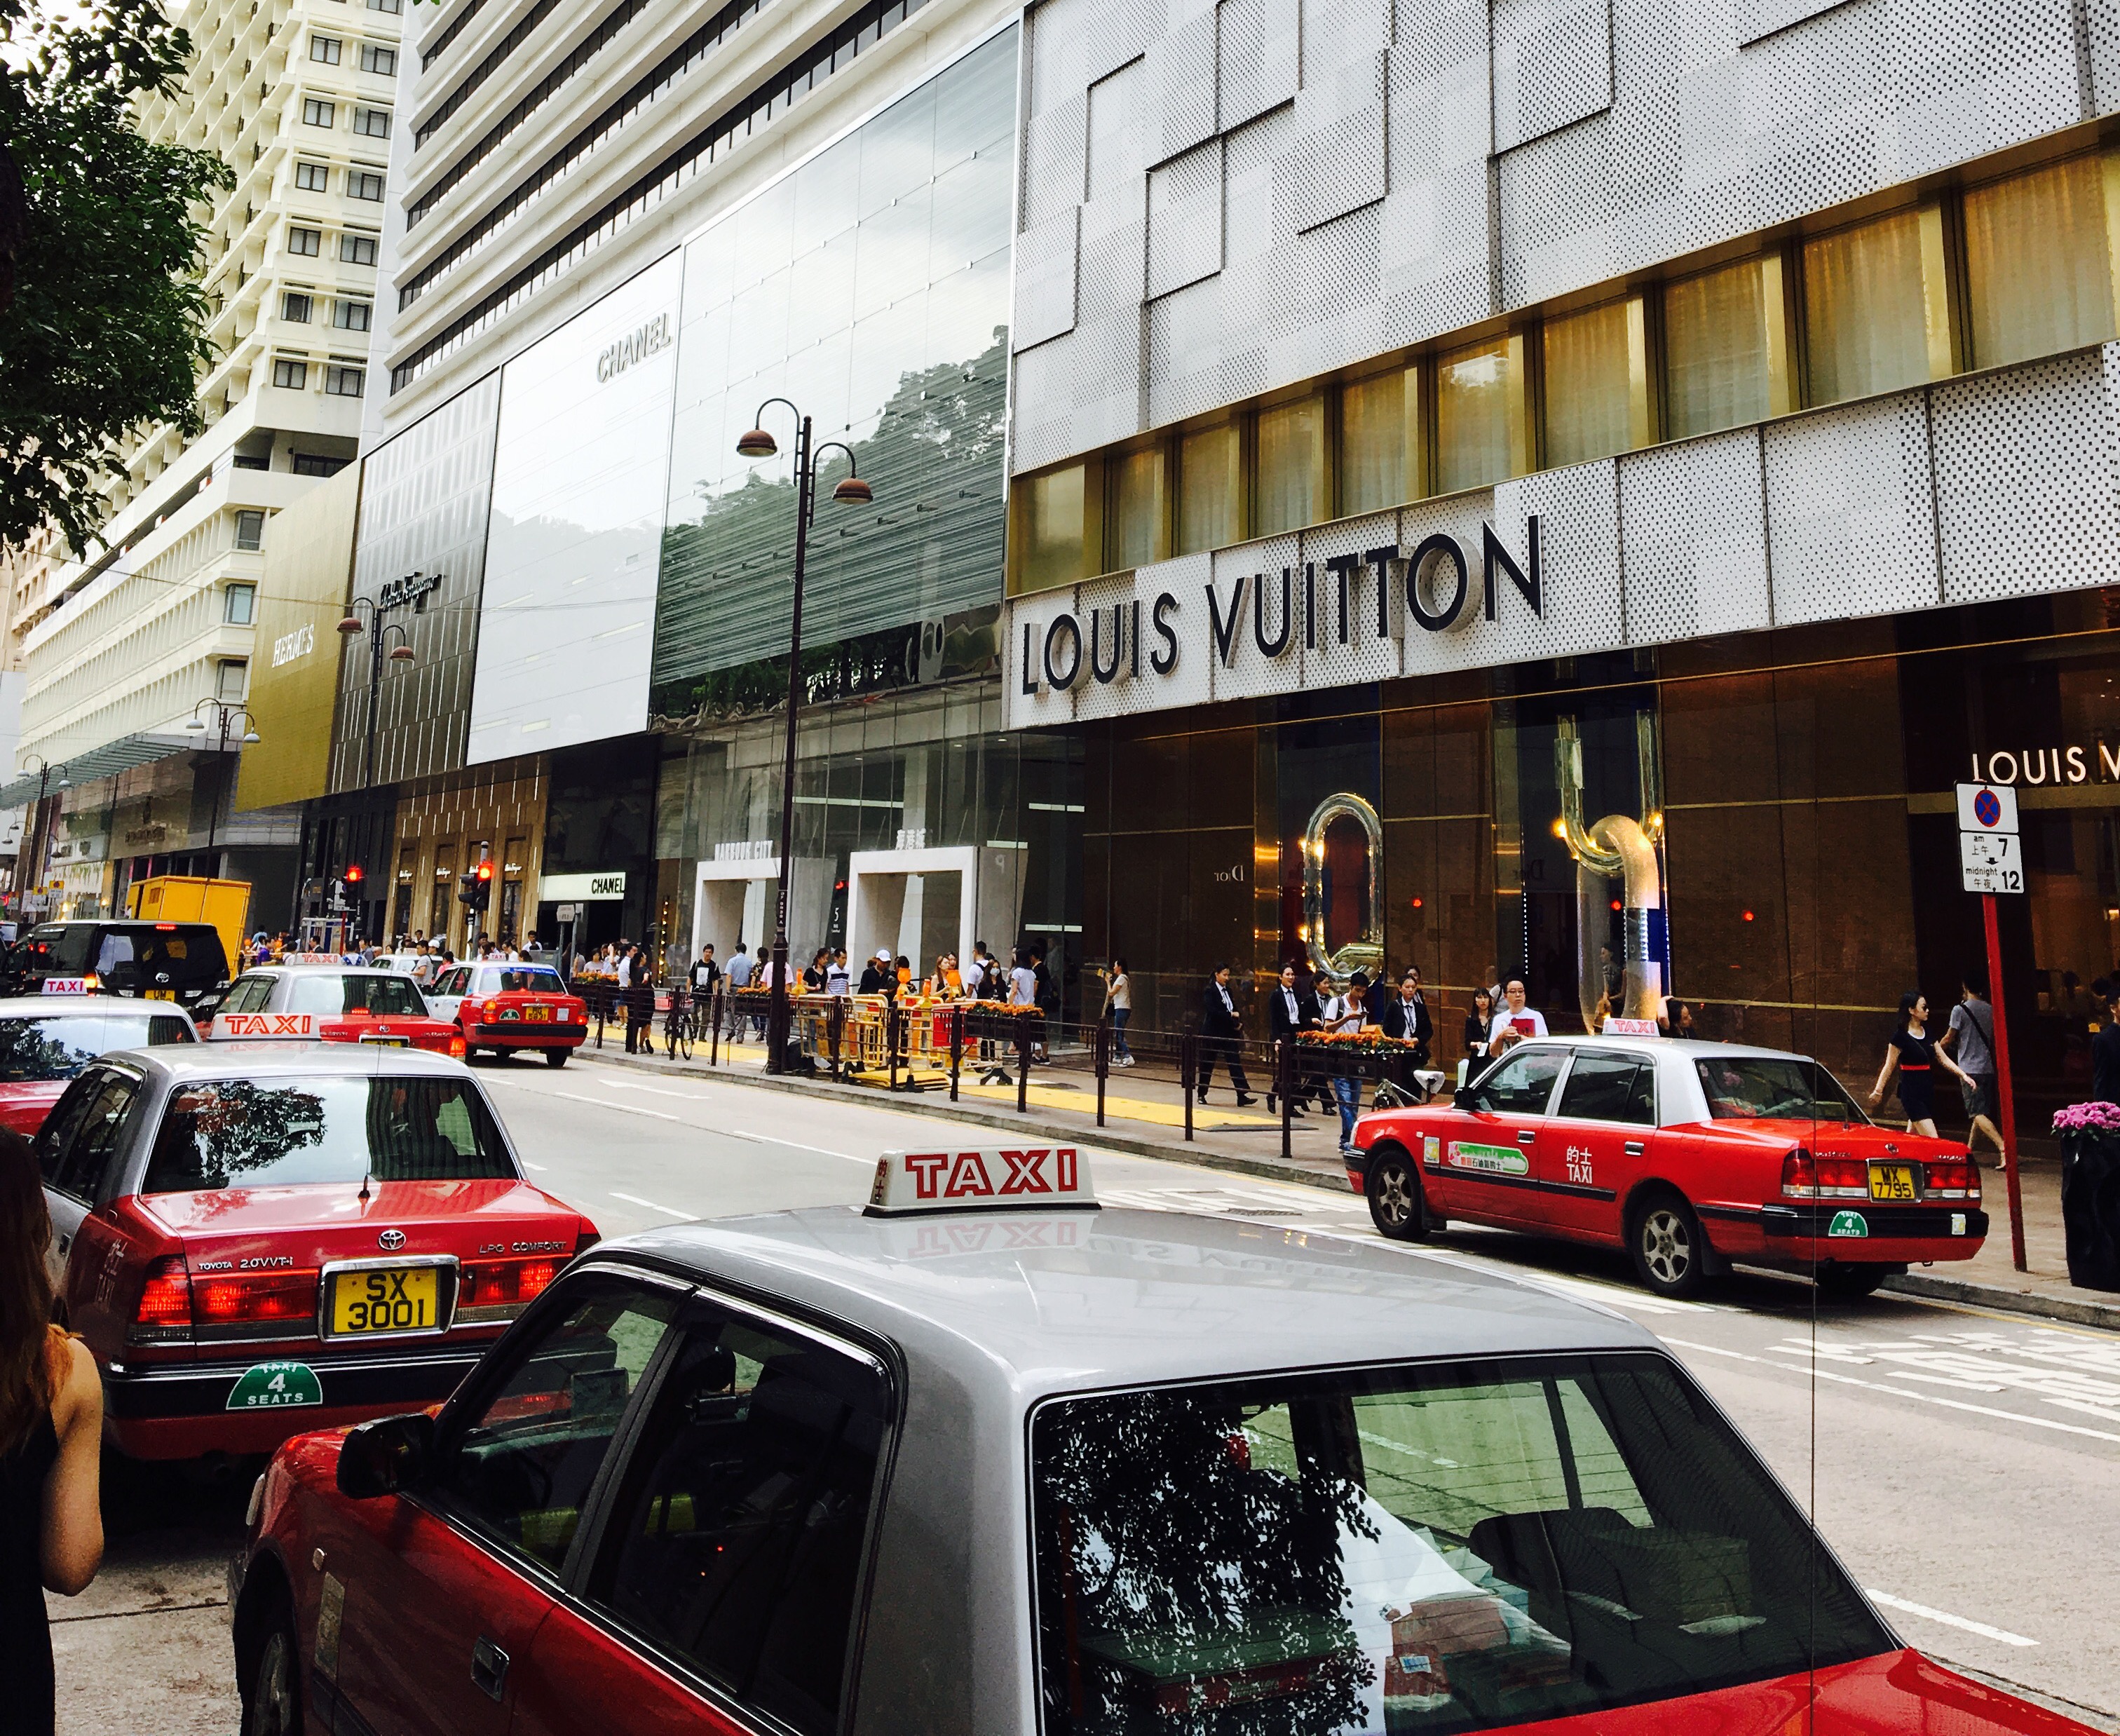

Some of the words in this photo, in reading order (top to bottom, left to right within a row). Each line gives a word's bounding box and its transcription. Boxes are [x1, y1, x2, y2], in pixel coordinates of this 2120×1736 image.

[597, 313, 672, 383] CHANEL
[1023, 592, 1181, 696] LOUIS
[1205, 515, 1544, 668] VUITTON
[1972, 746, 2086, 785] LOUIS
[1971, 845, 1989, 855] 上午
[1998, 838, 2008, 856] 7
[1966, 867, 1998, 876] midnight
[591, 878, 625, 894] CHANEL
[2002, 871, 2020, 890] 12
[302, 954, 339, 963] TAXI
[47, 981, 83, 992] TAXI
[224, 1015, 312, 1035] TAXI
[1615, 1019, 1656, 1034] TAXI
[1566, 1145, 1592, 1165] 的士
[905, 1148, 1078, 1200] TAXI
[1566, 1163, 1592, 1184] TAXI
[1880, 1167, 1899, 1183] MX
[1875, 1182, 1912, 1198] 7795
[1844, 1218, 1853, 1228] 4
[479, 1244, 505, 1254] LPG
[512, 1241, 566, 1252] COMFORT
[198, 1261, 233, 1270] TOYOTA
[367, 1272, 408, 1301] SX
[348, 1298, 424, 1329] 3001
[259, 1362, 298, 1374] TAXI
[267, 1373, 286, 1392] 4
[247, 1392, 304, 1405] SEATS
